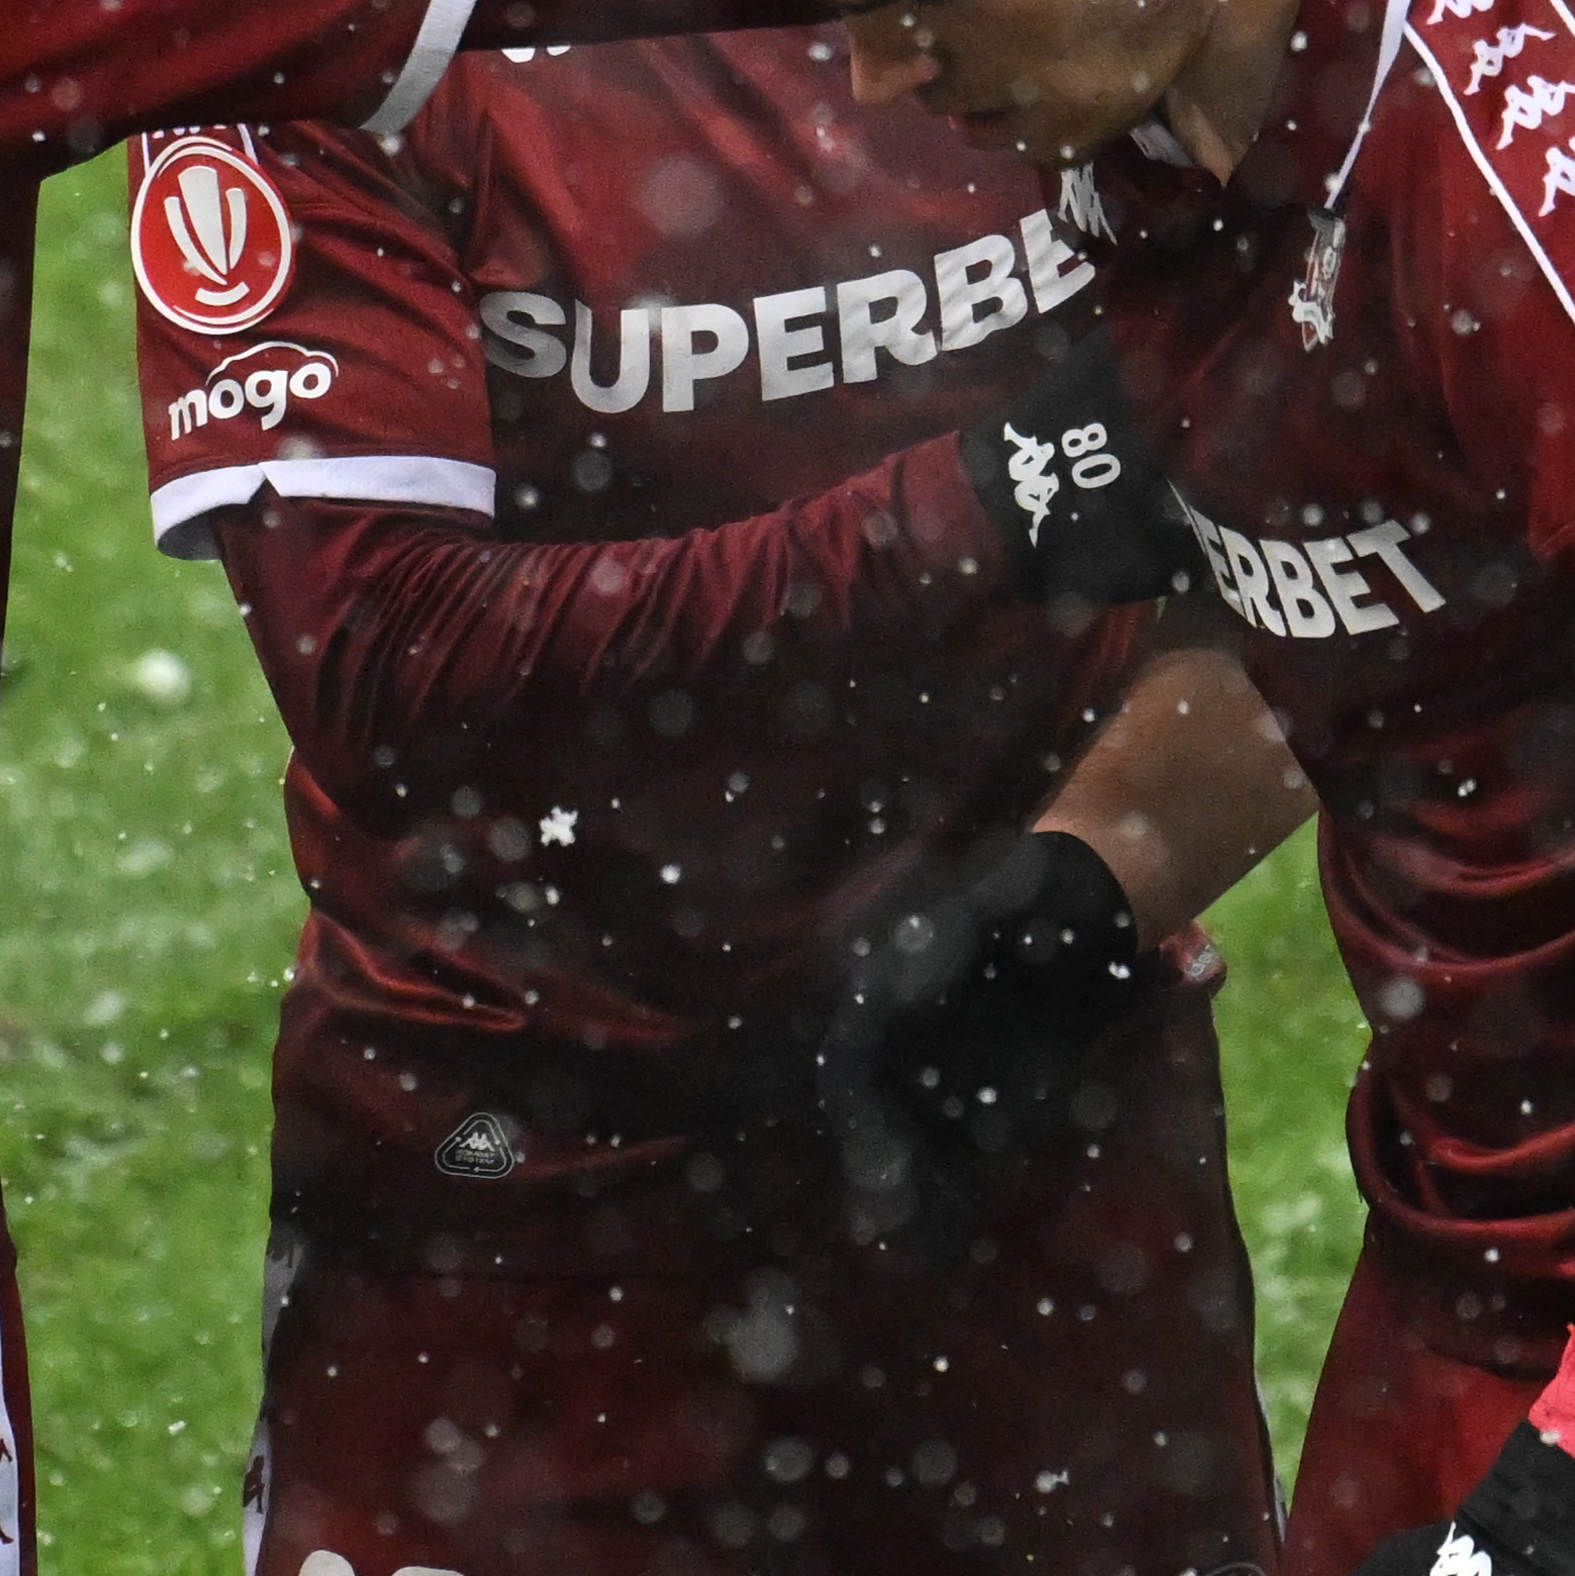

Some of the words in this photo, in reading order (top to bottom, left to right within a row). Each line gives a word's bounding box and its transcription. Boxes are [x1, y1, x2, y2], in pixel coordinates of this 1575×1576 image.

[480, 208, 1097, 414] SUPERBE
[168, 361, 332, 441] mogo
[1061, 422, 1121, 489] 80
[1167, 479, 1448, 639] ERBET
